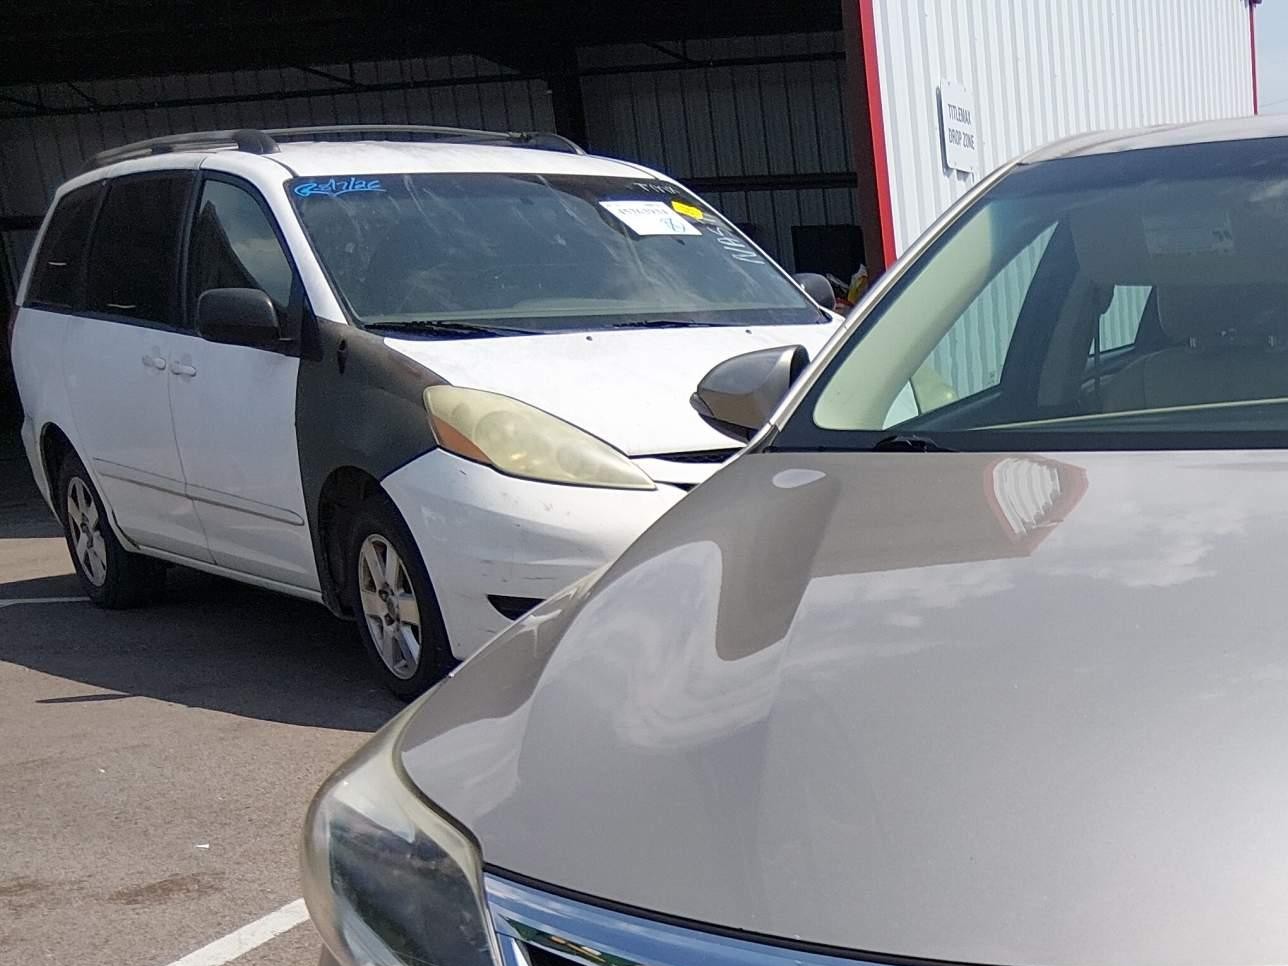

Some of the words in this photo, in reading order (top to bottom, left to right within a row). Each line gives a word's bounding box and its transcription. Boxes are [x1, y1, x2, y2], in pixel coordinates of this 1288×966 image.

[948, 104, 971, 125] TITLEMAX
[948, 127, 962, 146] DROP
[962, 132, 975, 151] ZONE
